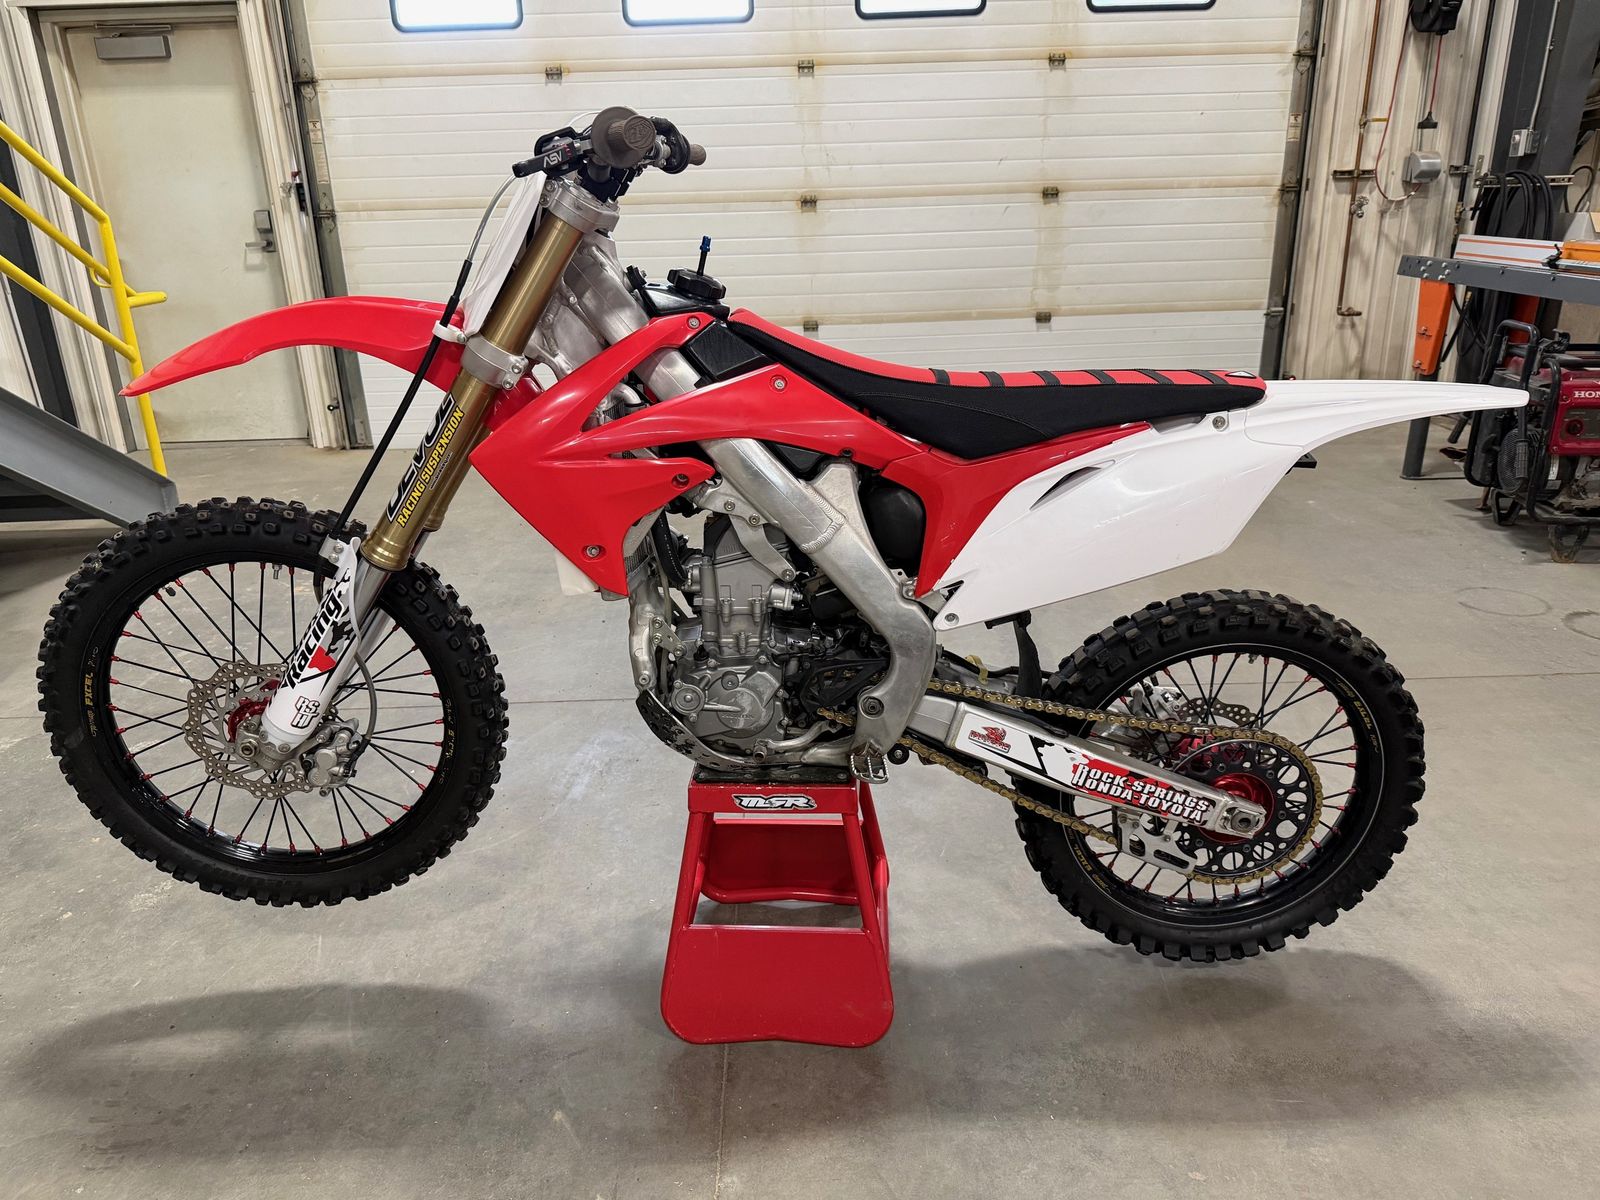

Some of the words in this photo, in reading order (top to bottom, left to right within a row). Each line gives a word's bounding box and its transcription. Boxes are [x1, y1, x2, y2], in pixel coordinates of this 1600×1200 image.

[543, 150, 562, 168] ASV
[396, 481, 426, 528] RACING
[420, 407, 464, 483] SUSPENSION
[286, 589, 344, 689] Racing
